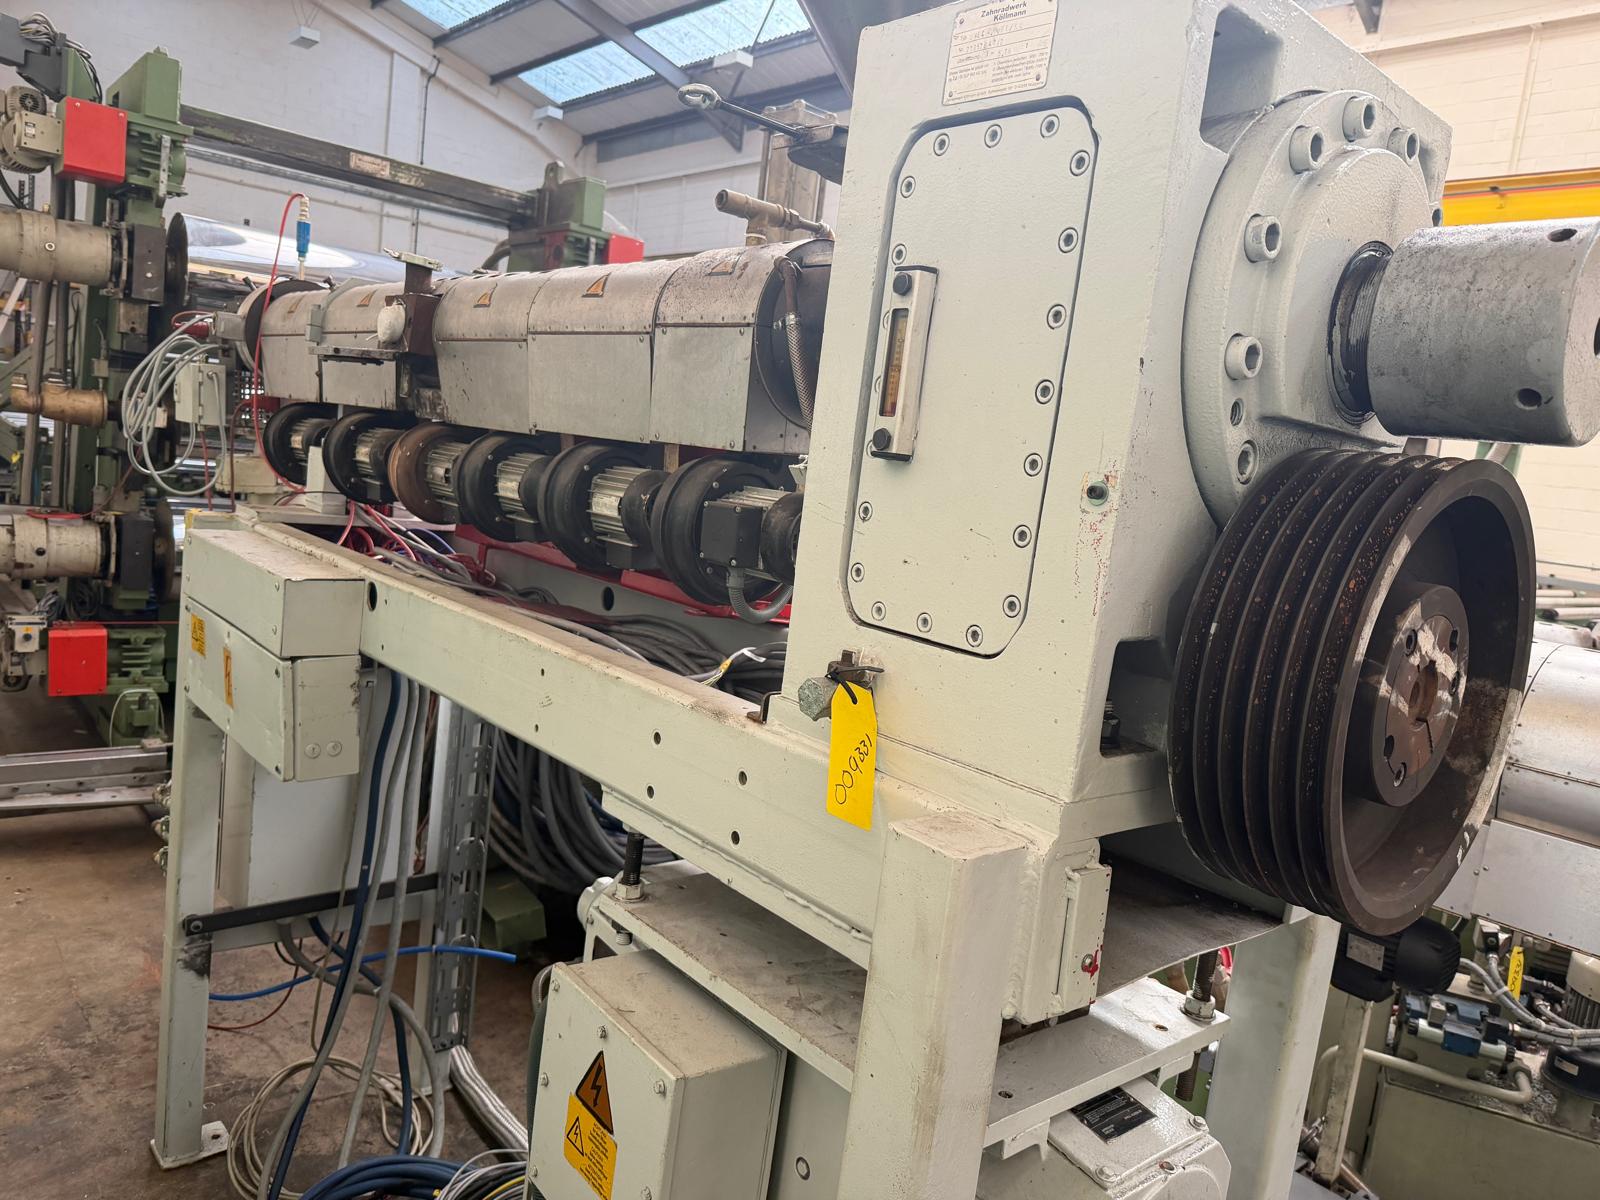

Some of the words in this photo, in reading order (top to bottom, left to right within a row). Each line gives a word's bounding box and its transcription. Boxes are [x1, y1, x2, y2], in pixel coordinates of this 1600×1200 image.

[981, 1, 1027, 18] Zahnradwerk
[993, 9, 1027, 22] Köllmann
[834, 733, 873, 805] 009331
